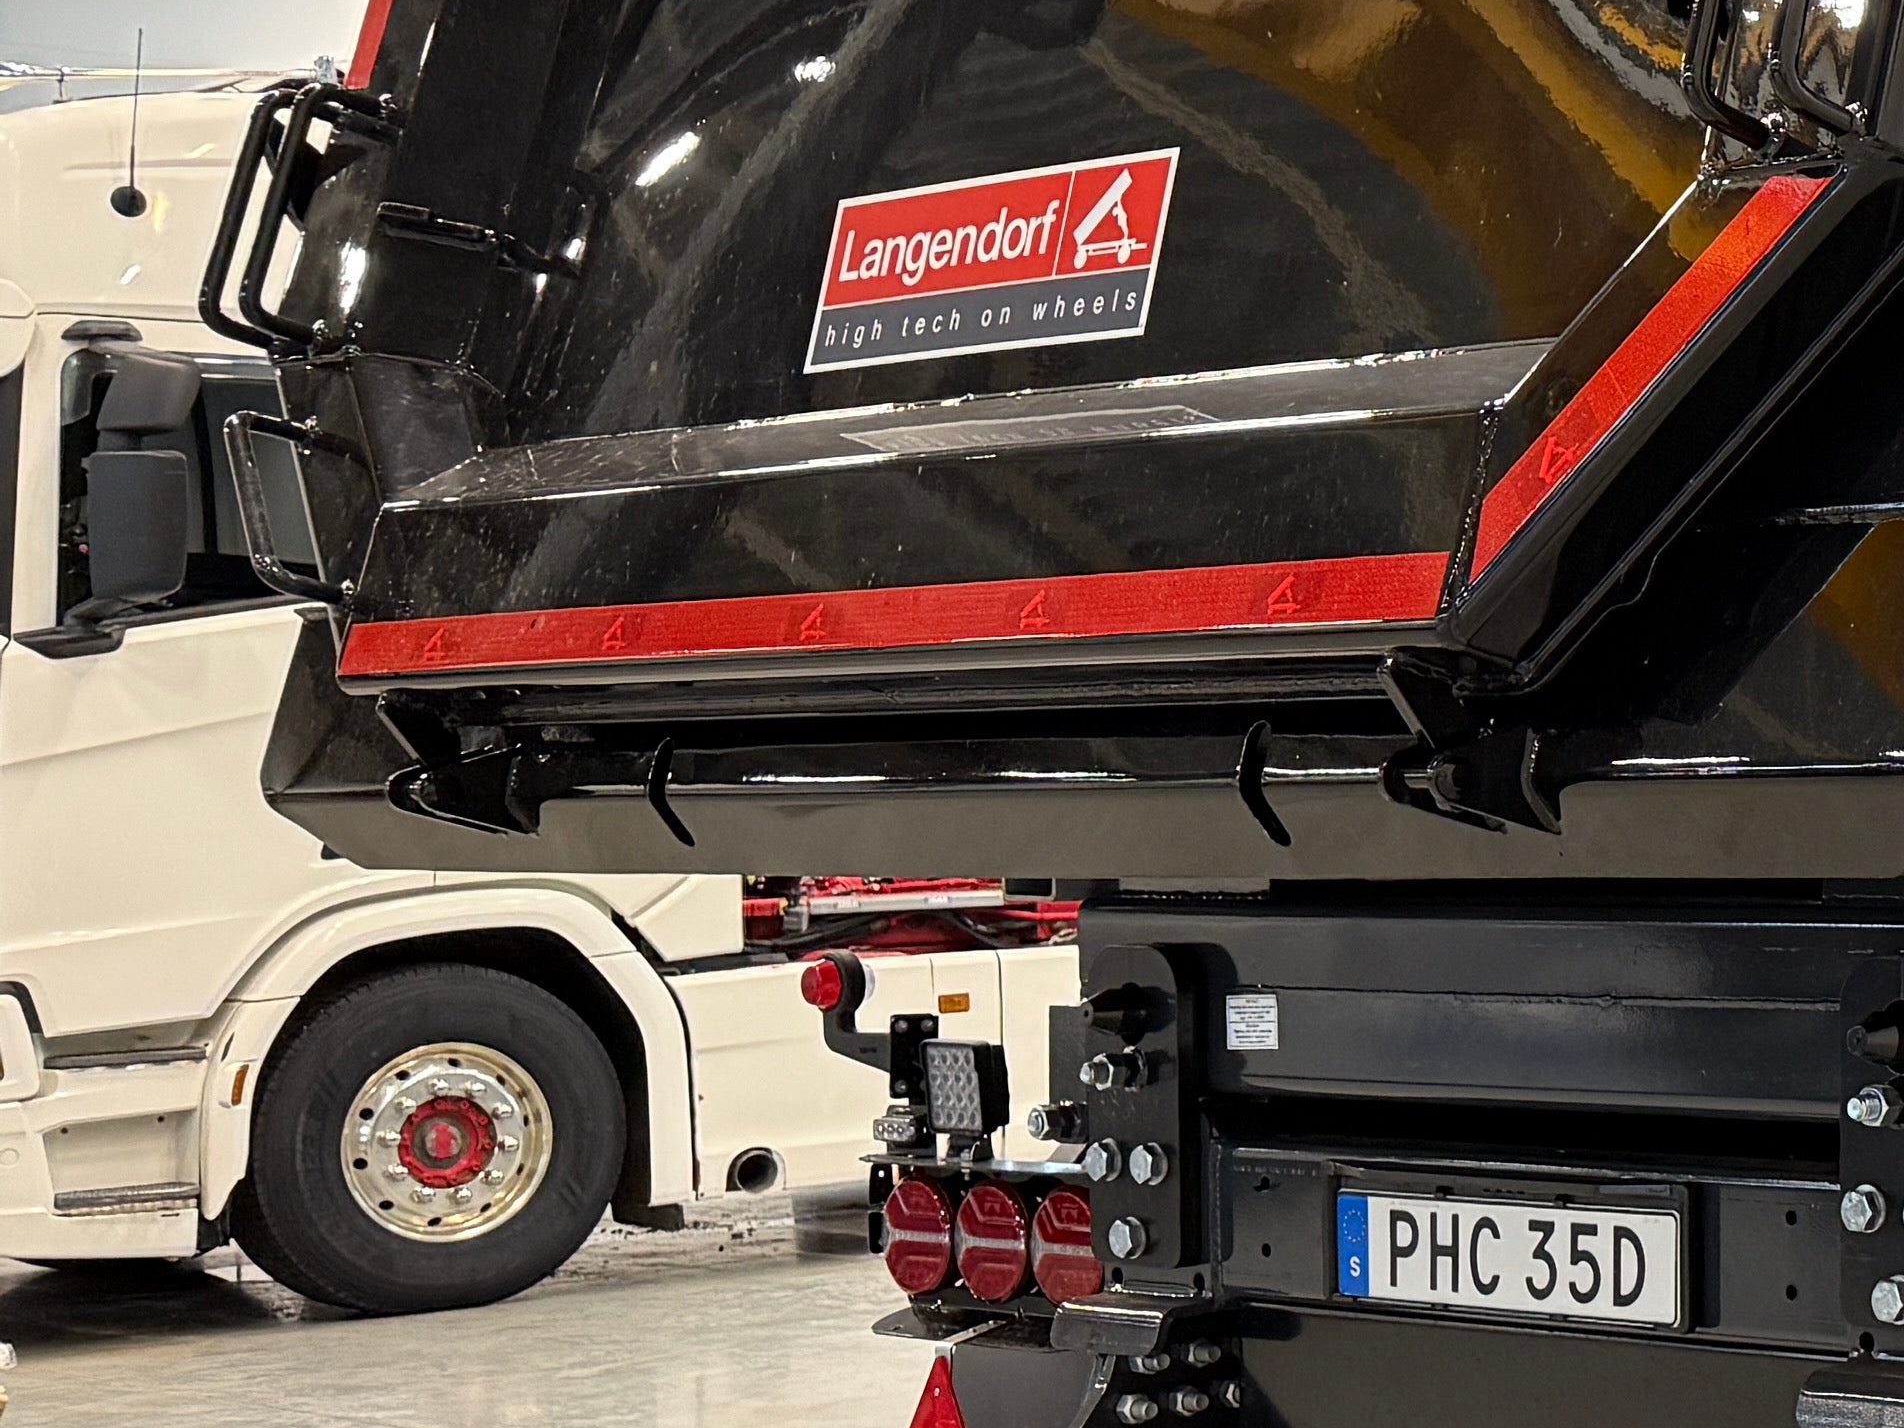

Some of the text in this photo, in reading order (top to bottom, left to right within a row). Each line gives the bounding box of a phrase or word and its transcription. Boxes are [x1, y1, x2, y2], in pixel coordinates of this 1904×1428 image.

[837, 198, 1062, 287] Langendorf
[823, 288, 1138, 351] high tech on wheels
[1349, 1254, 1362, 1278] S
[1389, 1208, 1647, 1308] PHC 35D
